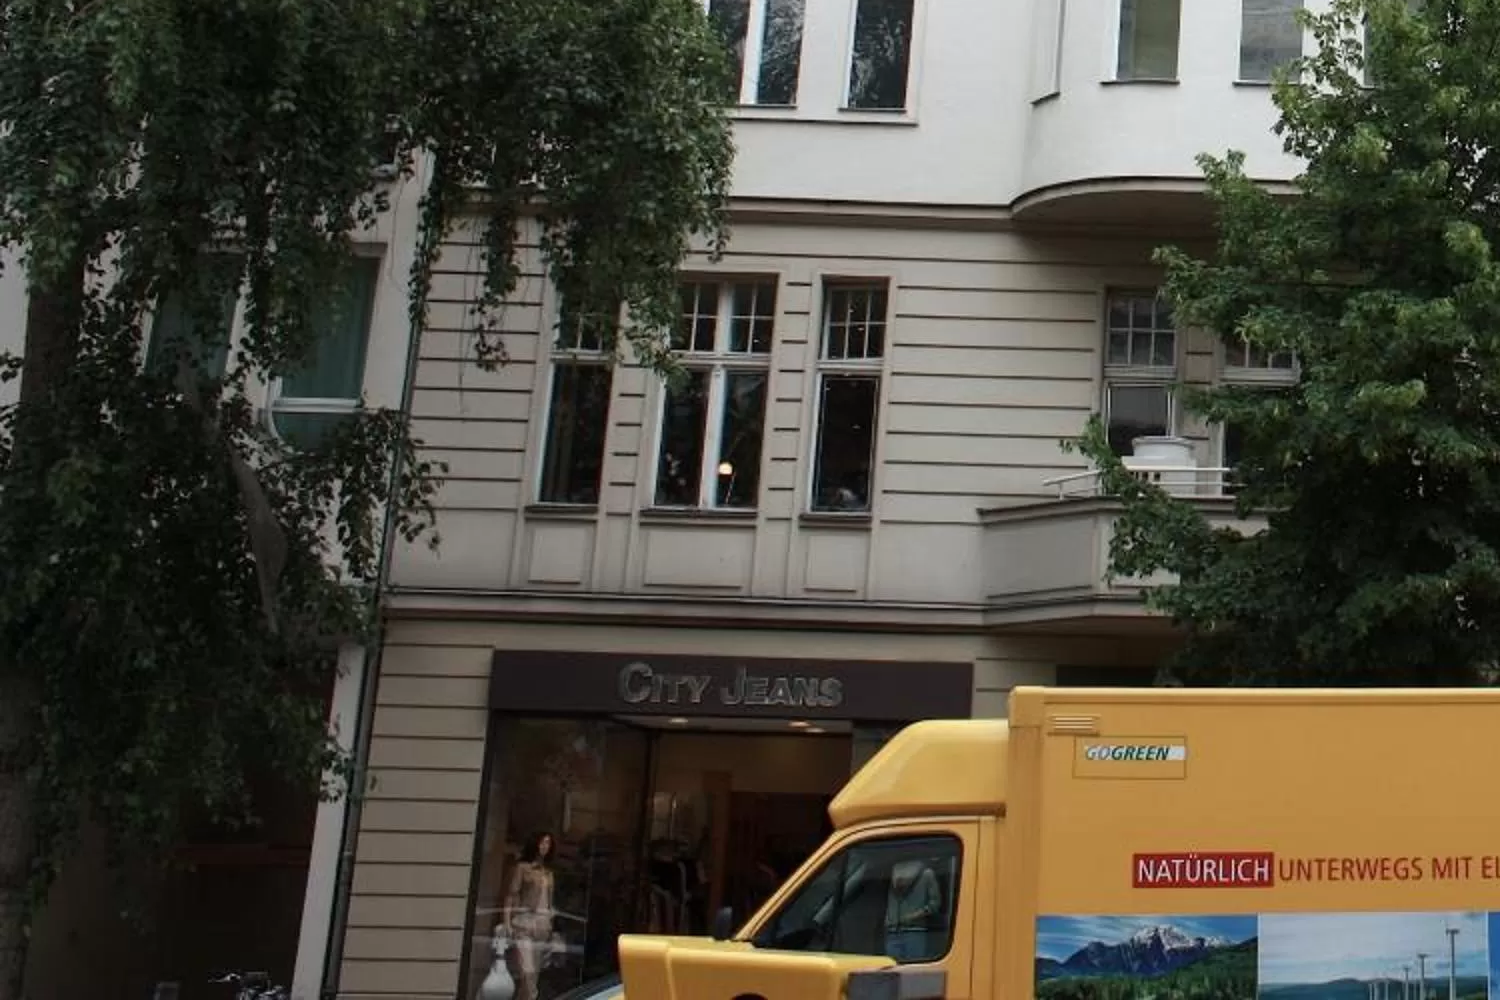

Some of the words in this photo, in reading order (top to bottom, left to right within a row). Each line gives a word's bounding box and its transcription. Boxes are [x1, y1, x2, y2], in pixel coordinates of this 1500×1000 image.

[1086, 745, 1169, 760] GOGREEN
[1137, 854, 1270, 882] NATÜRLICH
[1279, 857, 1423, 882] UNTERWEGS
[1432, 856, 1473, 881] MIT
